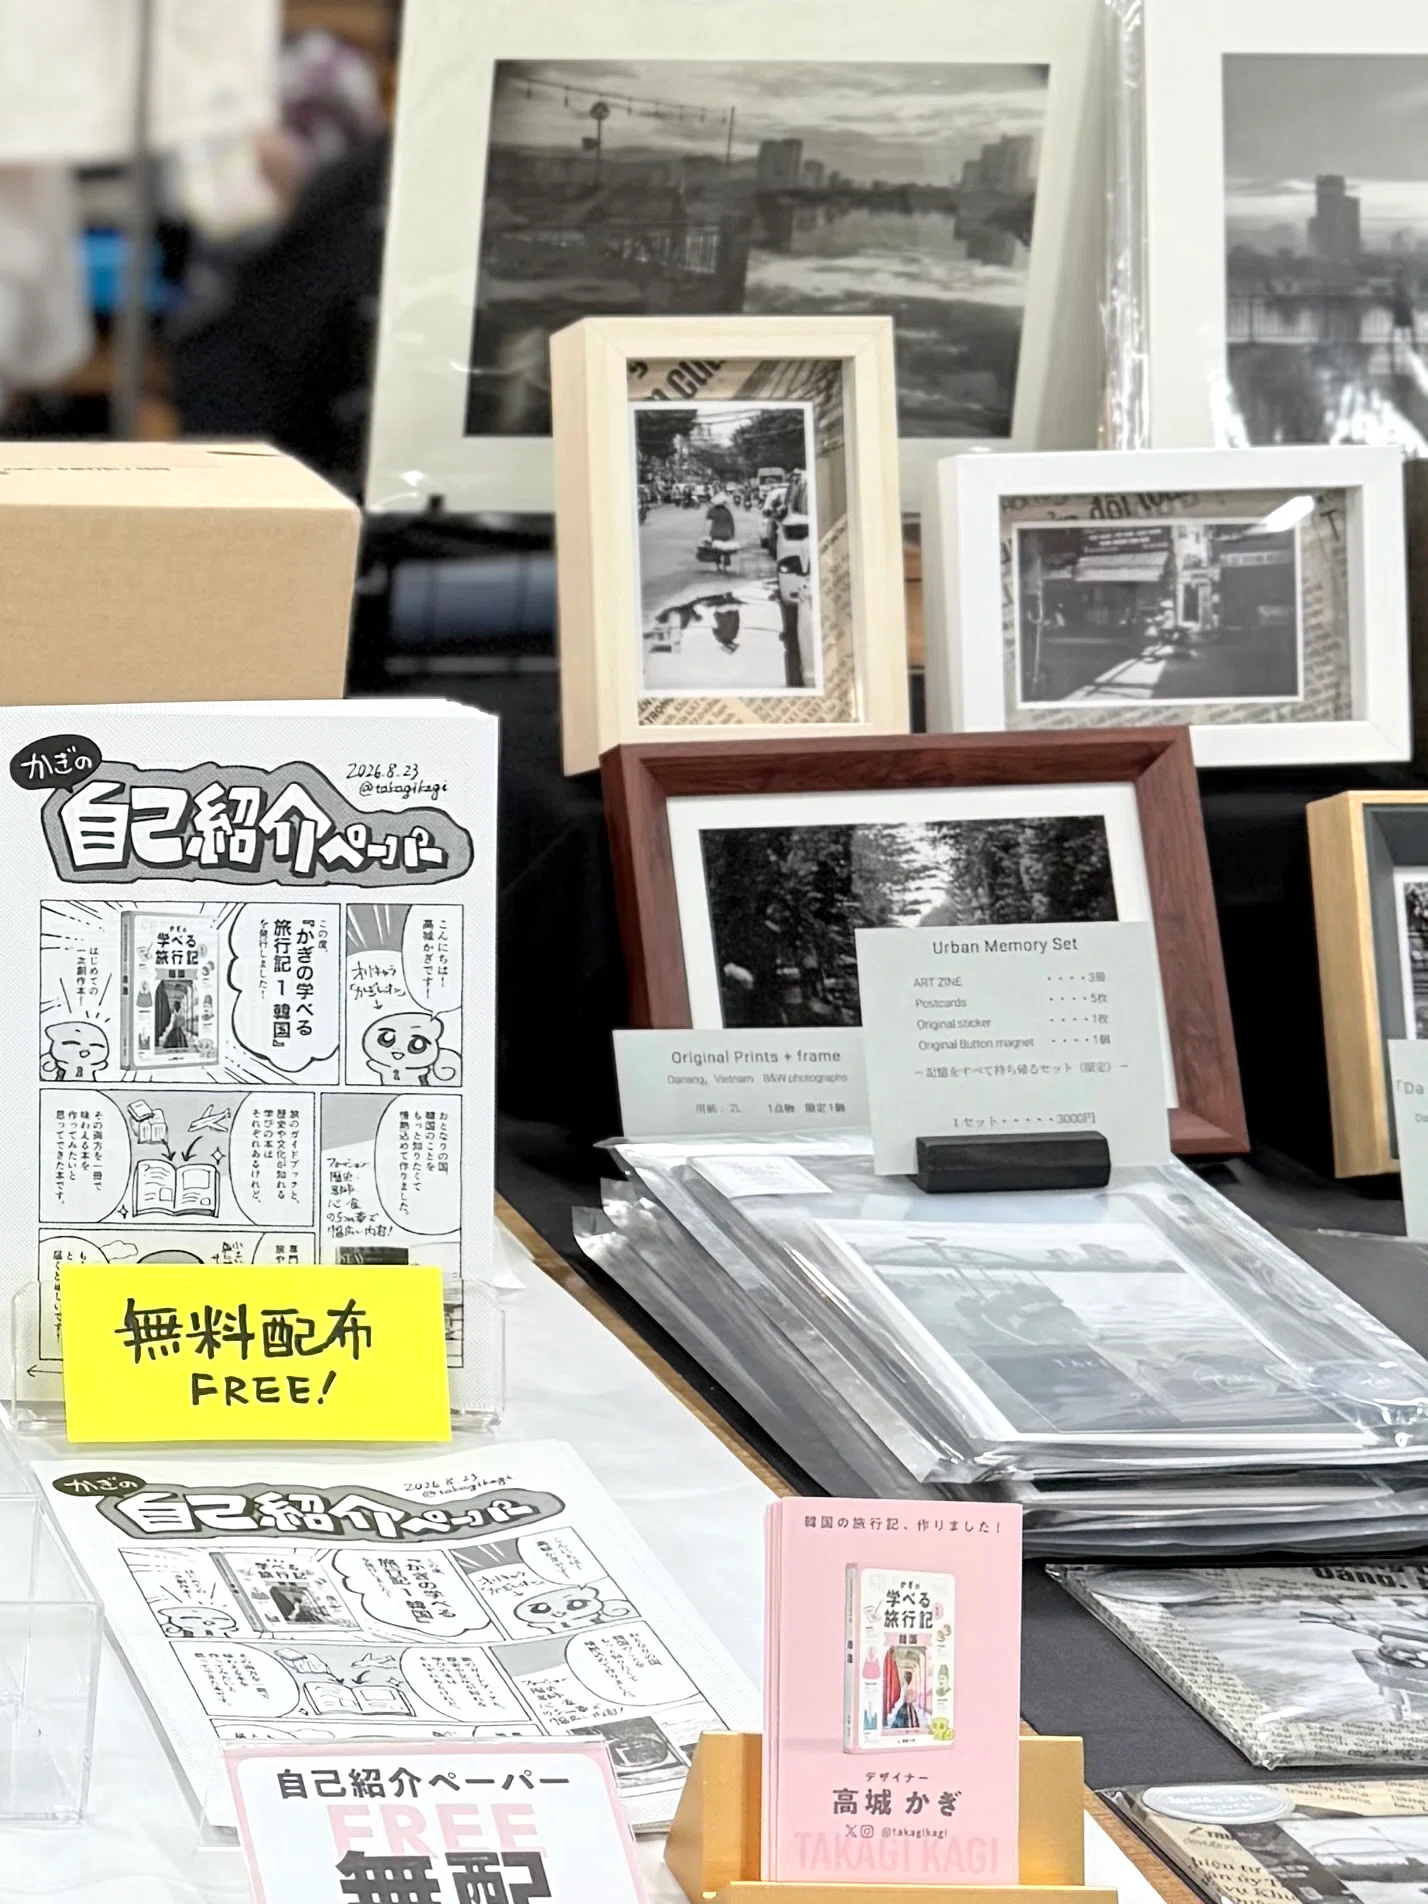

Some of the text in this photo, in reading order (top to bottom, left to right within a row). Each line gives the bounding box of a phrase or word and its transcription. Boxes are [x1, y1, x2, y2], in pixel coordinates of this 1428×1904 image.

[58, 781, 447, 876] 自己紹介ペーパー
[933, 937, 1078, 955] Urban Memory Set
[296, 918, 314, 1037] 『かぎの学べる
[914, 978, 934, 988] ART
[916, 998, 967, 1009] Postcards
[273, 1004, 291, 1048] 韓国』
[671, 1051, 729, 1066] Original
[735, 1050, 778, 1063] Prints
[797, 1049, 840, 1062] frame
[264, 1109, 274, 1159] 学びの本は
[115, 1297, 374, 1362] 無料配布
[191, 1368, 337, 1408] FREE!
[123, 1491, 535, 1539] 自己紹介ペーパー
[804, 1515, 1001, 1534] 韓国の旅行記、作りました！
[278, 1767, 570, 1800] 自己紹介ペーパー
[865, 1771, 929, 1783] デザイナー
[832, 1788, 962, 1816] 高城 かぎ
[328, 1804, 548, 1858] FREE
[881, 1825, 948, 1839] @takagikagi
[794, 1831, 999, 1874] TAKAGI KAGI
